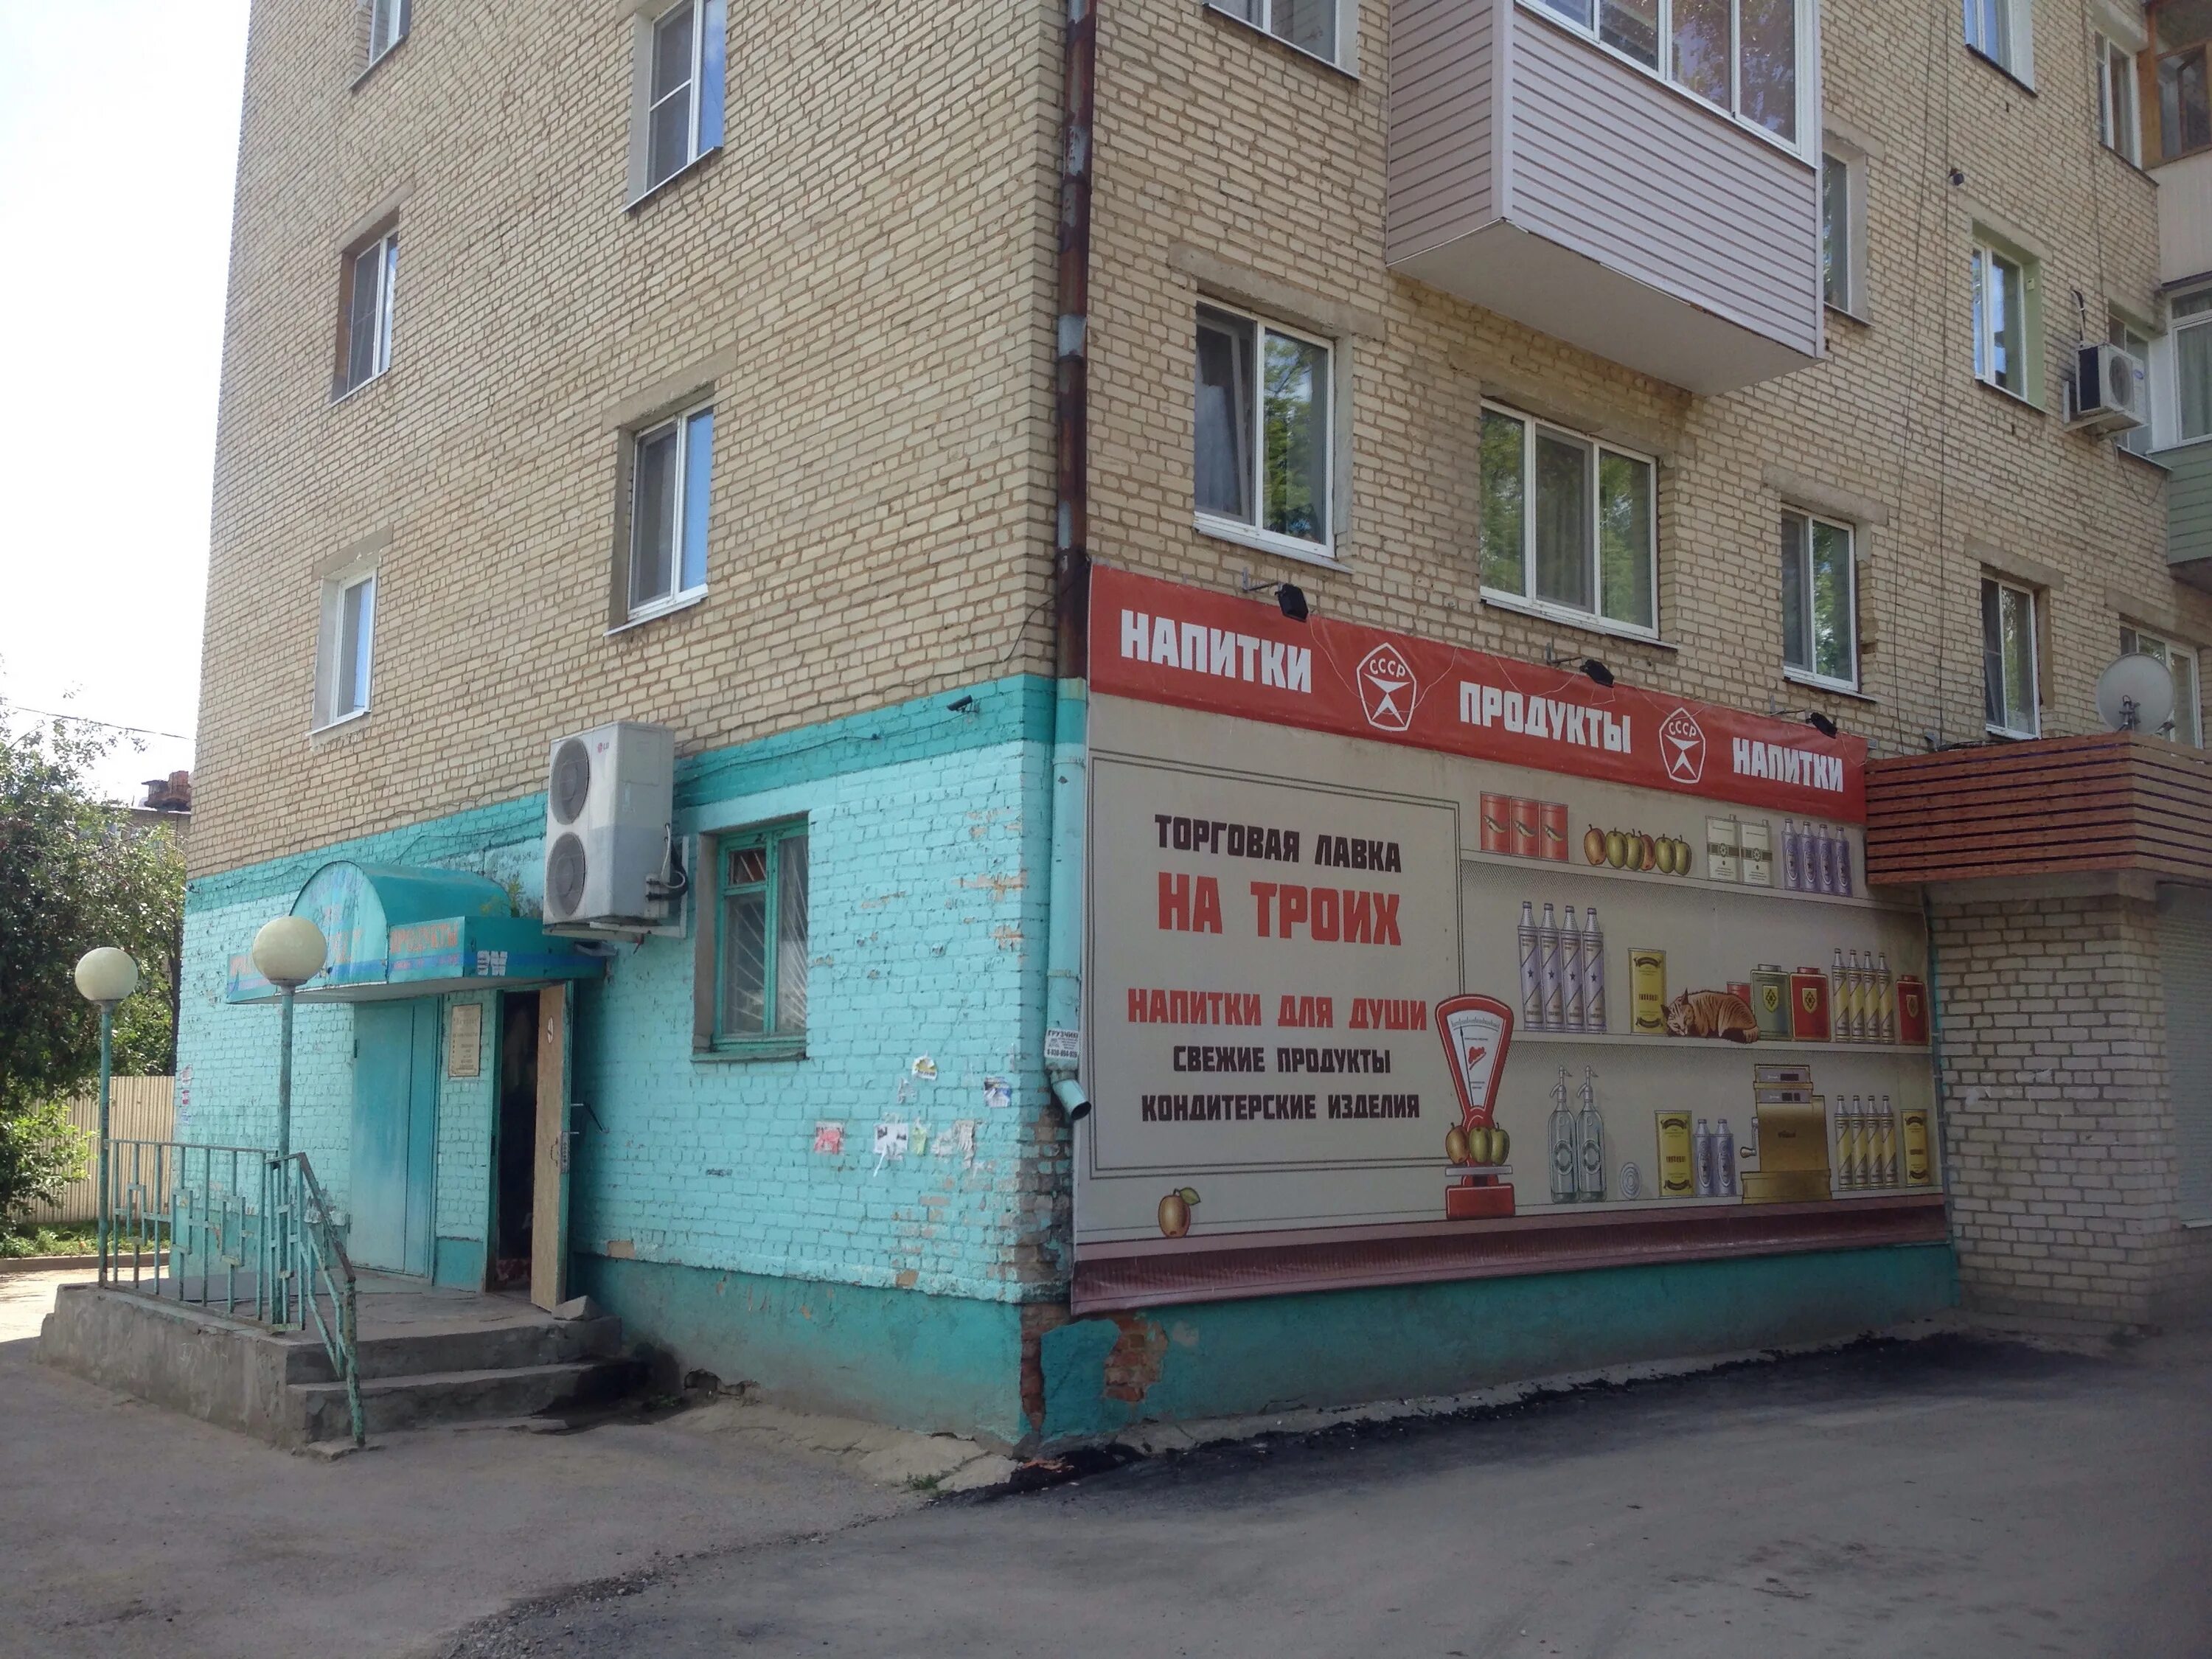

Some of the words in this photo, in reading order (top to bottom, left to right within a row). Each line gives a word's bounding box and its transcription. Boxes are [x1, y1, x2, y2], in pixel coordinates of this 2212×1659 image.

[1369, 657, 1406, 678] СССР
[1121, 608, 1312, 694] НАПИТКИ
[1460, 681, 1631, 754] ПРОДУКТЫ
[1733, 737, 1843, 793] НАПИТКИ
[1669, 720, 1697, 737] СССР
[1155, 814, 1300, 863] ТОРГОВАЯ
[1314, 834, 1402, 874] ЛАВКА
[1158, 872, 1223, 934] НА
[1250, 881, 1402, 946] ТРОИХ
[1127, 988, 1262, 1026] НАПИТКИ
[1277, 995, 1333, 1029] ДЛЯ
[1349, 998, 1427, 1031] ДУШИ
[1173, 1045, 1265, 1073] СВЕЖИЕ
[1276, 1047, 1391, 1074] ПРОДУКТЫ
[1141, 1094, 1316, 1122] КОНДИТЕРСКИЕ
[1327, 1093, 1420, 1119] ИЗДЕЛИЯ
